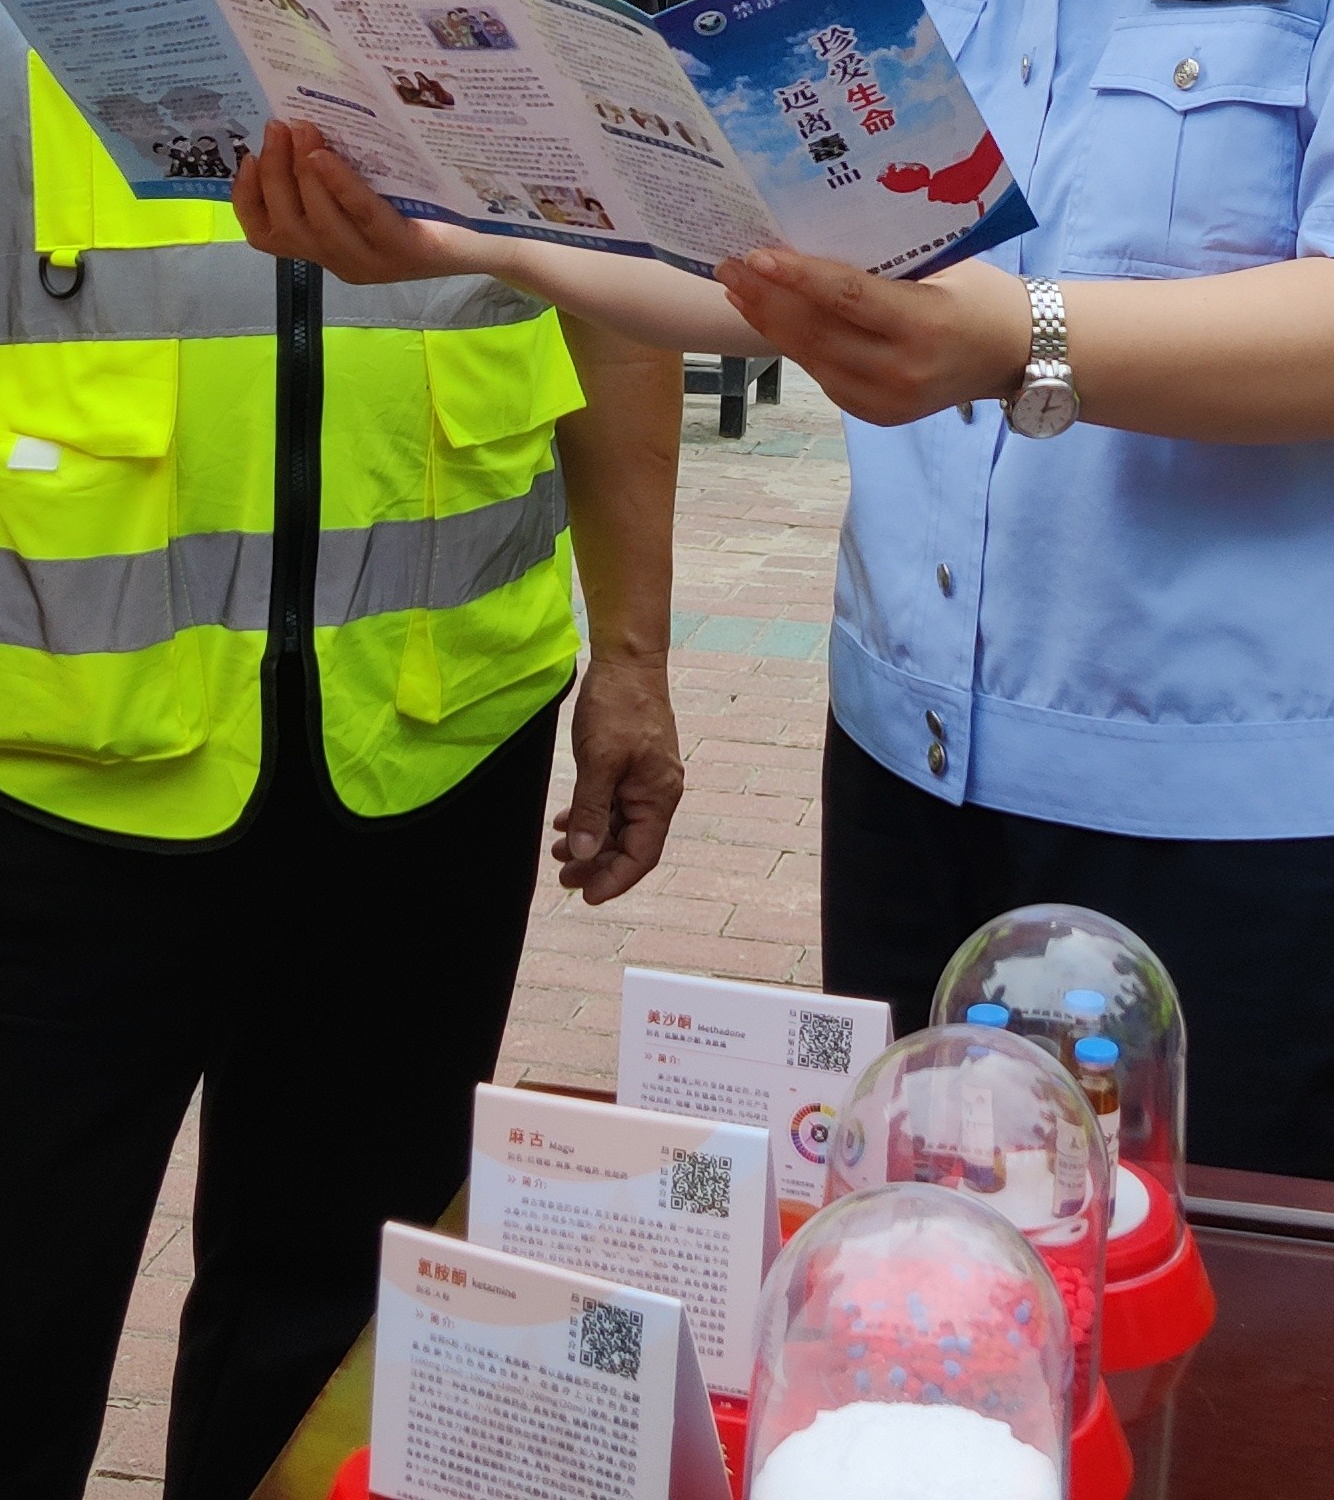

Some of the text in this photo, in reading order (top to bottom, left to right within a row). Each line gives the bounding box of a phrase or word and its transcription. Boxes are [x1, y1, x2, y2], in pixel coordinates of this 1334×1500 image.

[775, 80, 863, 190] 远离毒品
[813, 26, 896, 136] 珍爱生命
[697, 1023, 747, 1040] Methadone
